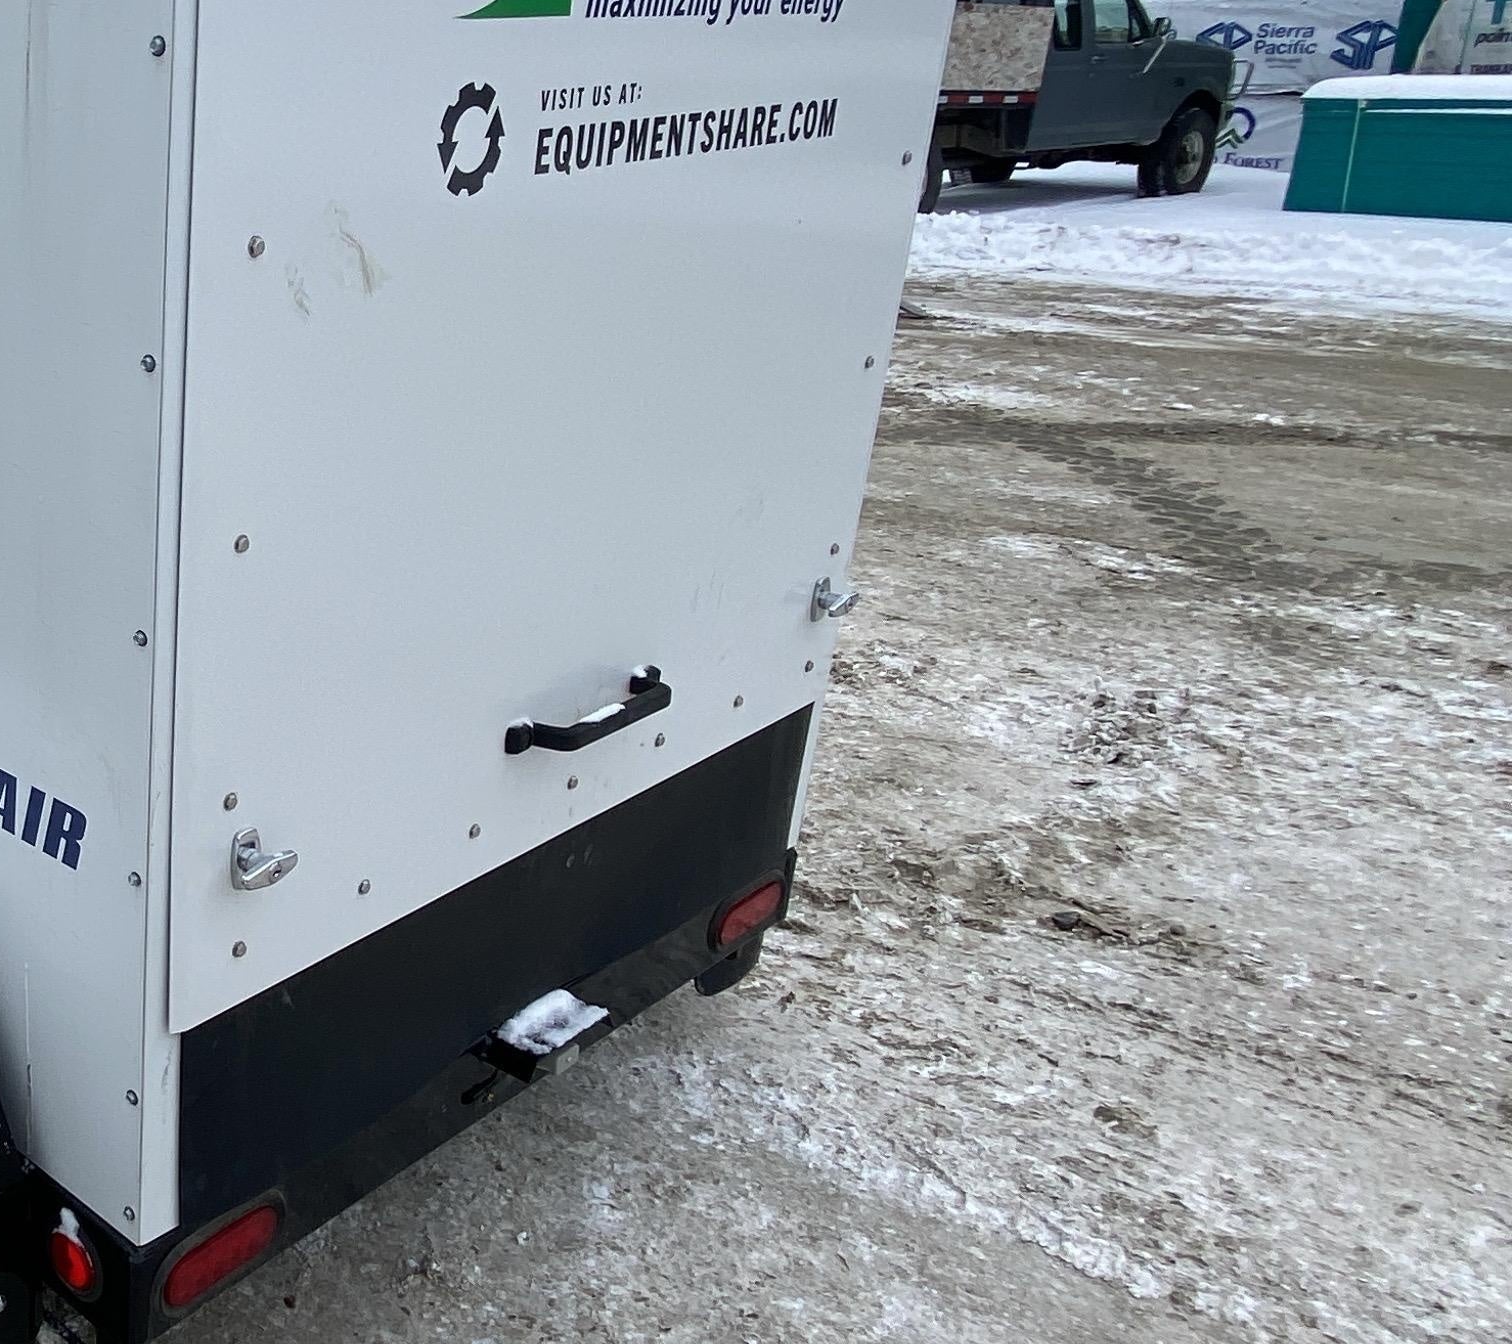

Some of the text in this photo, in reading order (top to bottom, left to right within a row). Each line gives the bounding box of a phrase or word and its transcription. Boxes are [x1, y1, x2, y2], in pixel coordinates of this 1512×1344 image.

[1256, 22, 1316, 39] Sierra
[1253, 39, 1319, 56] Pacific
[540, 82, 644, 112] VISIT US AT:
[533, 97, 840, 176] EQUIPMENTSHARE.COM
[1223, 151, 1285, 170] FOREST
